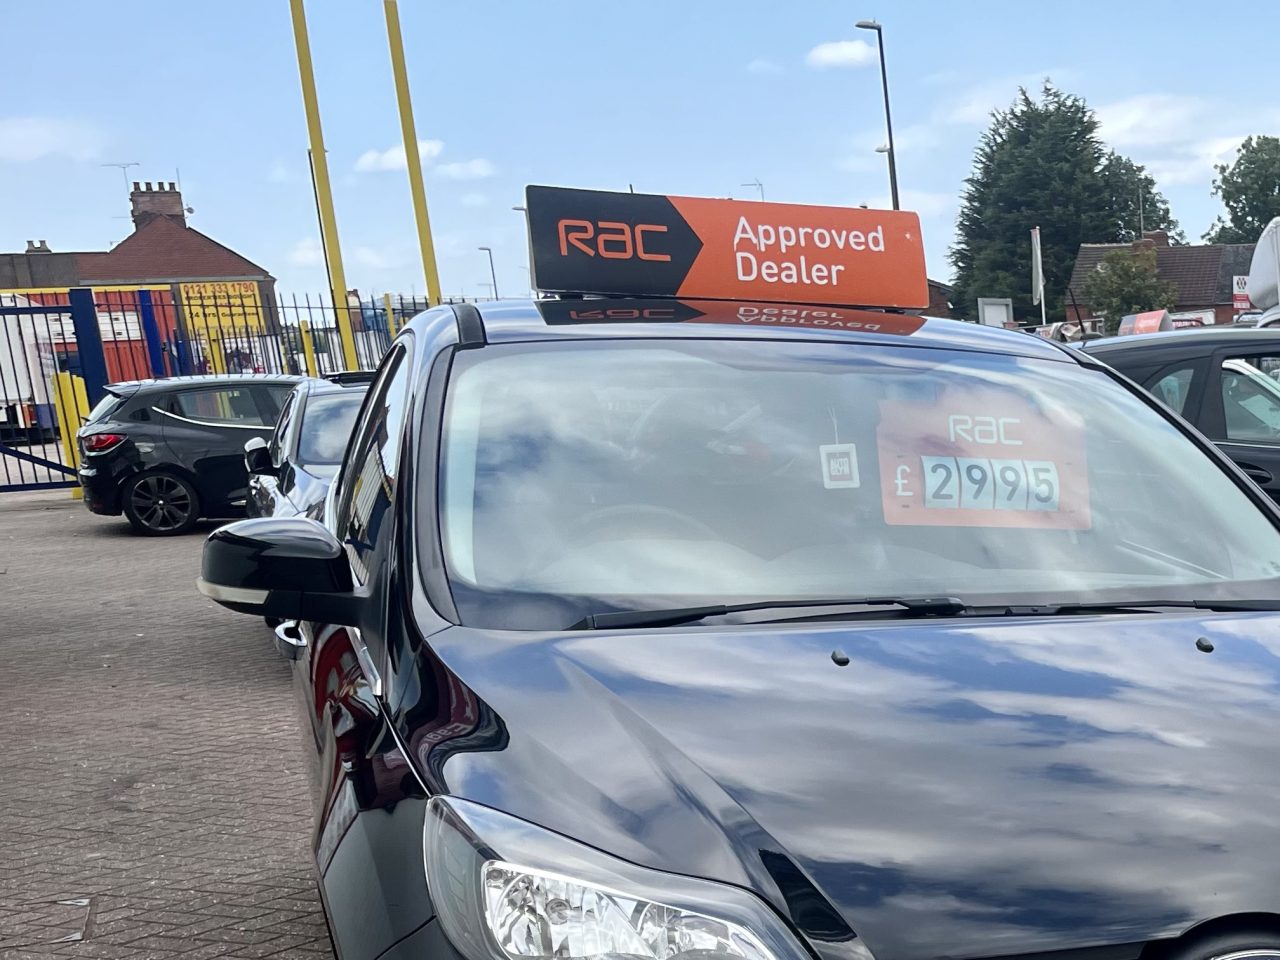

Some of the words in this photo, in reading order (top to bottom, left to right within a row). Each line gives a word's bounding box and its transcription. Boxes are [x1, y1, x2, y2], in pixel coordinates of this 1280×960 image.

[734, 216, 885, 252] Approved
[736, 252, 845, 286] Dealer
[231, 282, 255, 293] 1790
[930, 464, 1055, 503] 2995
